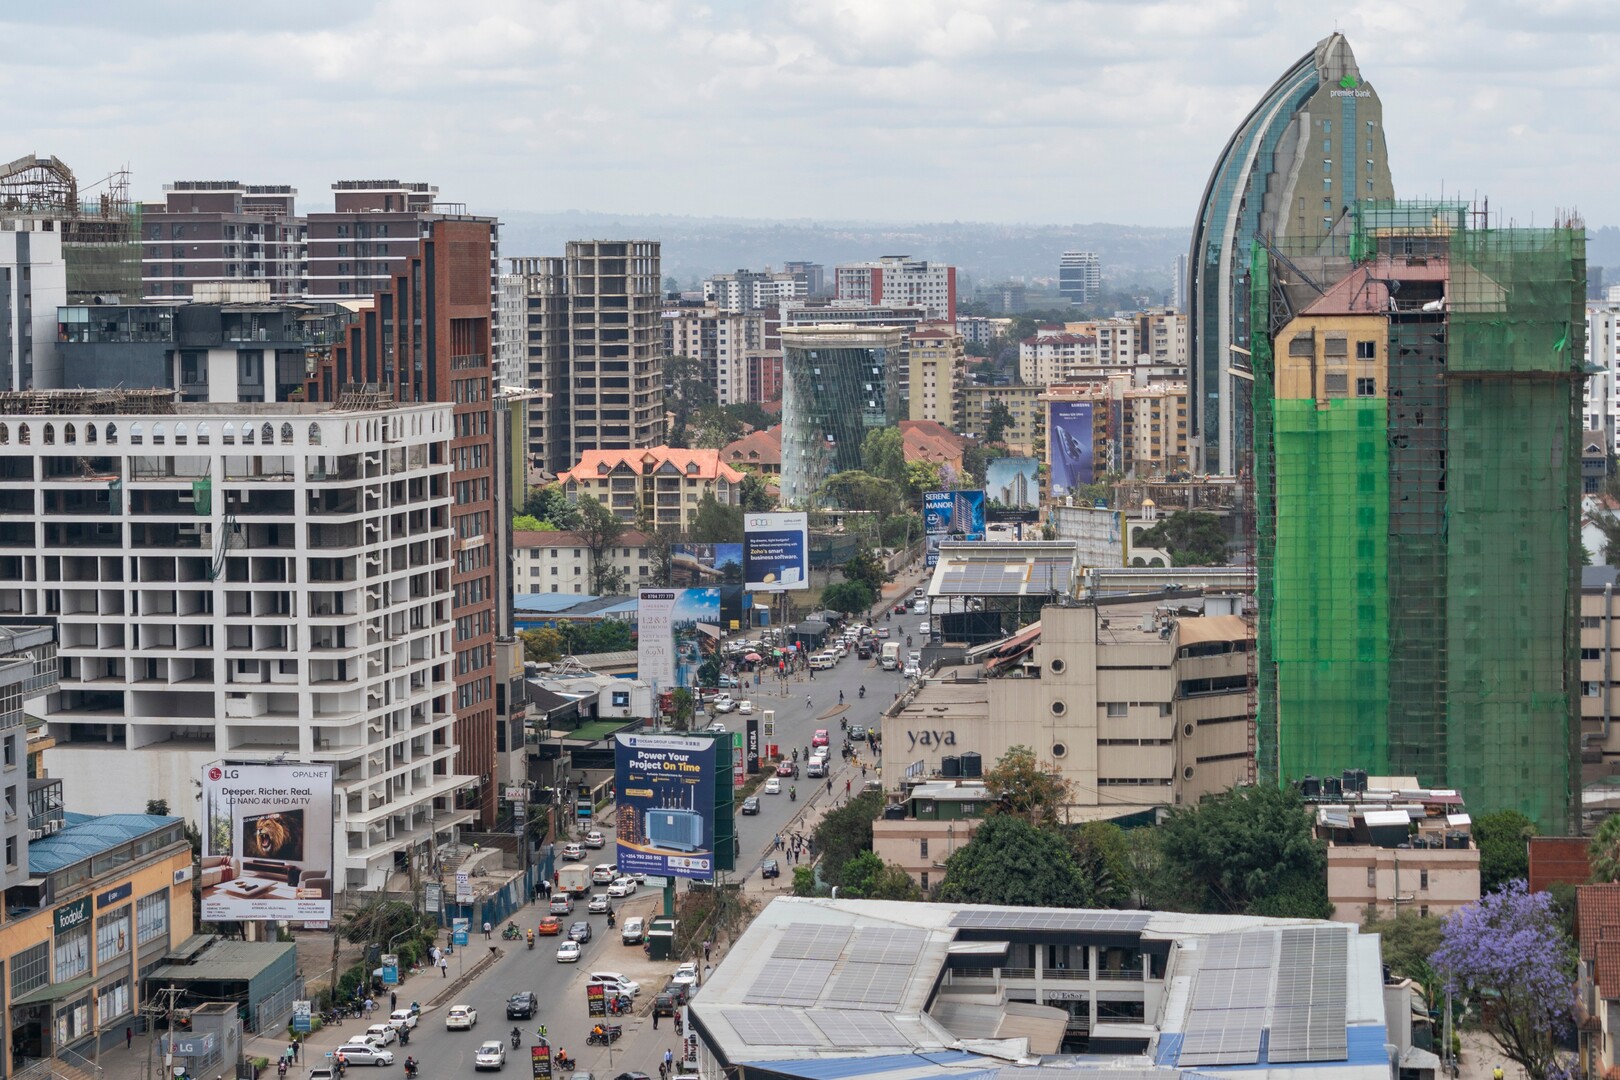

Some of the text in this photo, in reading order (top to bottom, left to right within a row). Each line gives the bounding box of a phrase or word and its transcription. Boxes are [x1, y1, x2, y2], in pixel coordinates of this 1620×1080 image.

[1330, 89, 1371, 98] premier bank
[907, 730, 956, 752] yaya
[638, 751, 689, 762] Power Your
[629, 760, 700, 772] Project On Time
[224, 770, 239, 779] LG
[222, 788, 313, 797] Deeper. Richer. Real.
[588, 986, 604, 996] 3M
[180, 1044, 193, 1052] LG
[532, 1048, 549, 1056] 3M
[689, 1034, 698, 1062] Shujah
